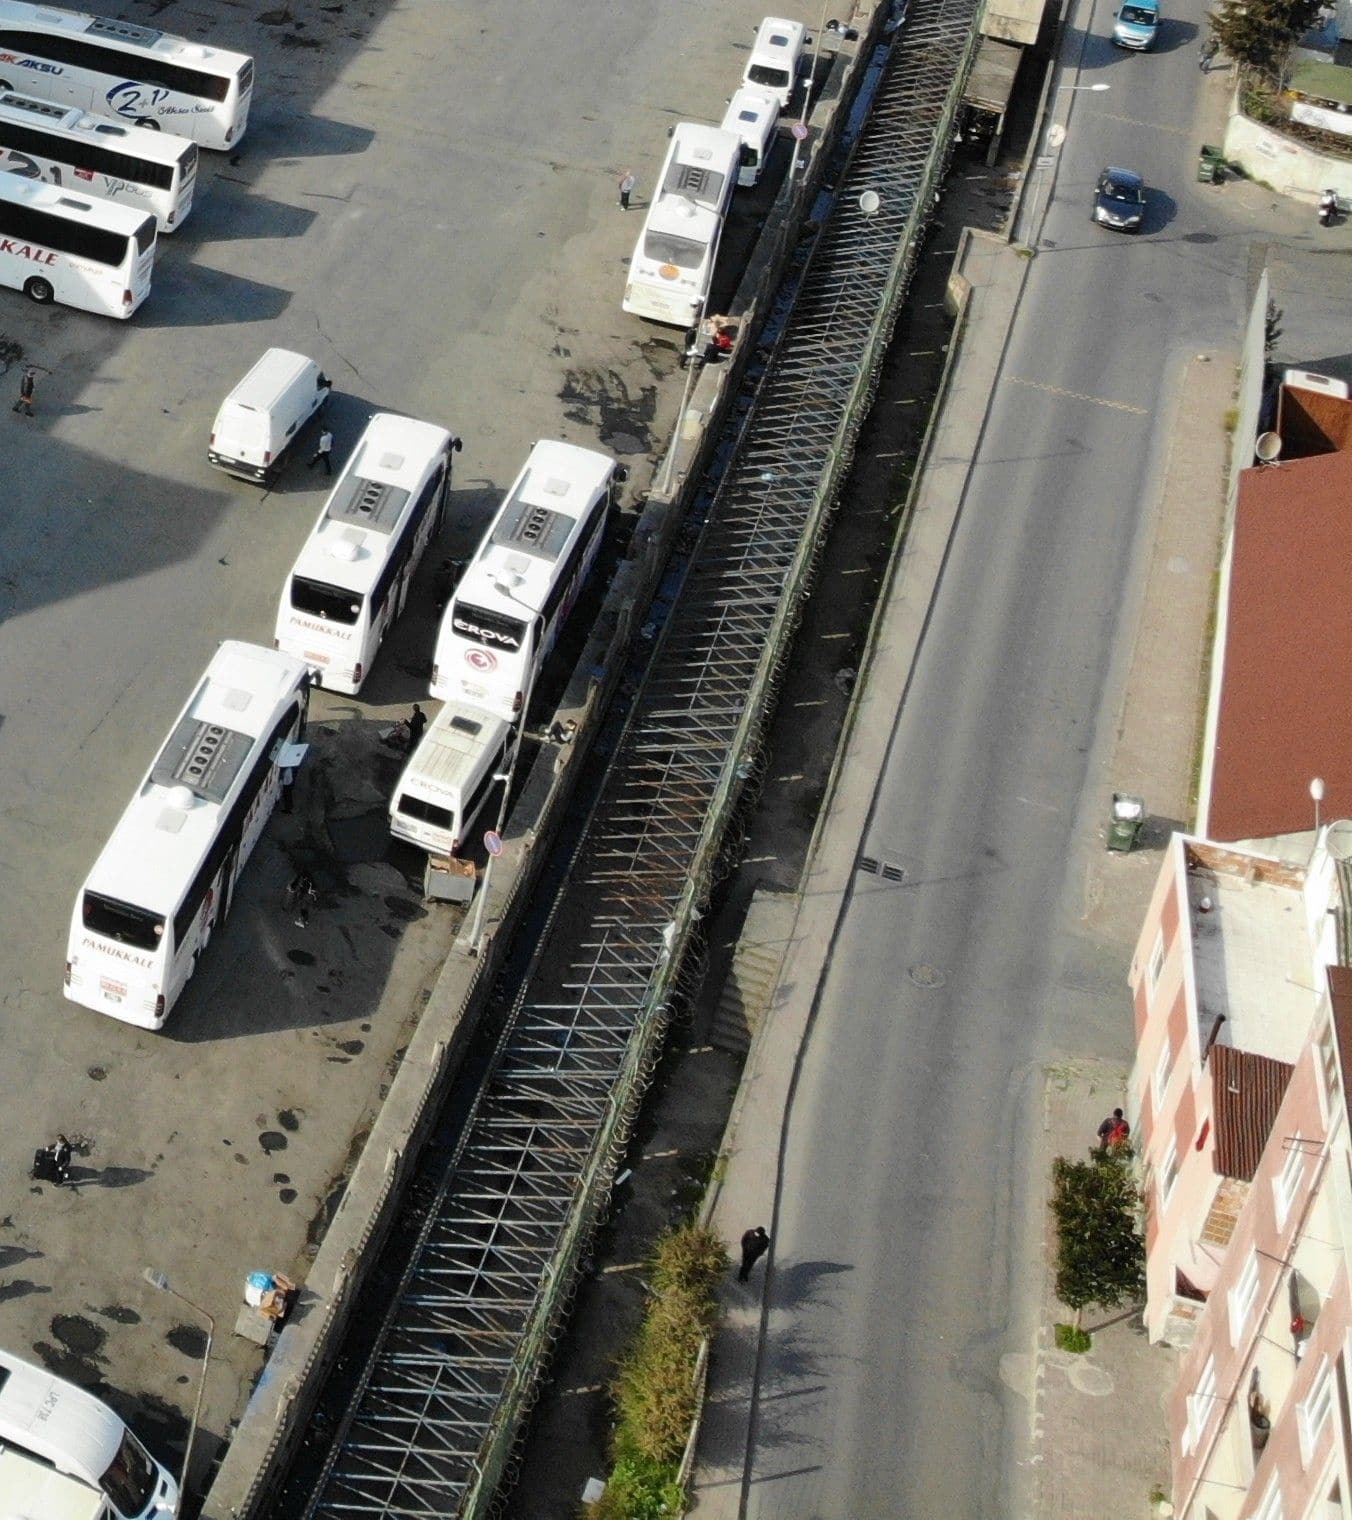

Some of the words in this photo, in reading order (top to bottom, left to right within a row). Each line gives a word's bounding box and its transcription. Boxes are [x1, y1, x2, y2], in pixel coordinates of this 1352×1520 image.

[14, 59, 64, 77] AKSU
[289, 616, 353, 641] PAMUKKALE
[82, 937, 155, 969] PAMUKKALE
